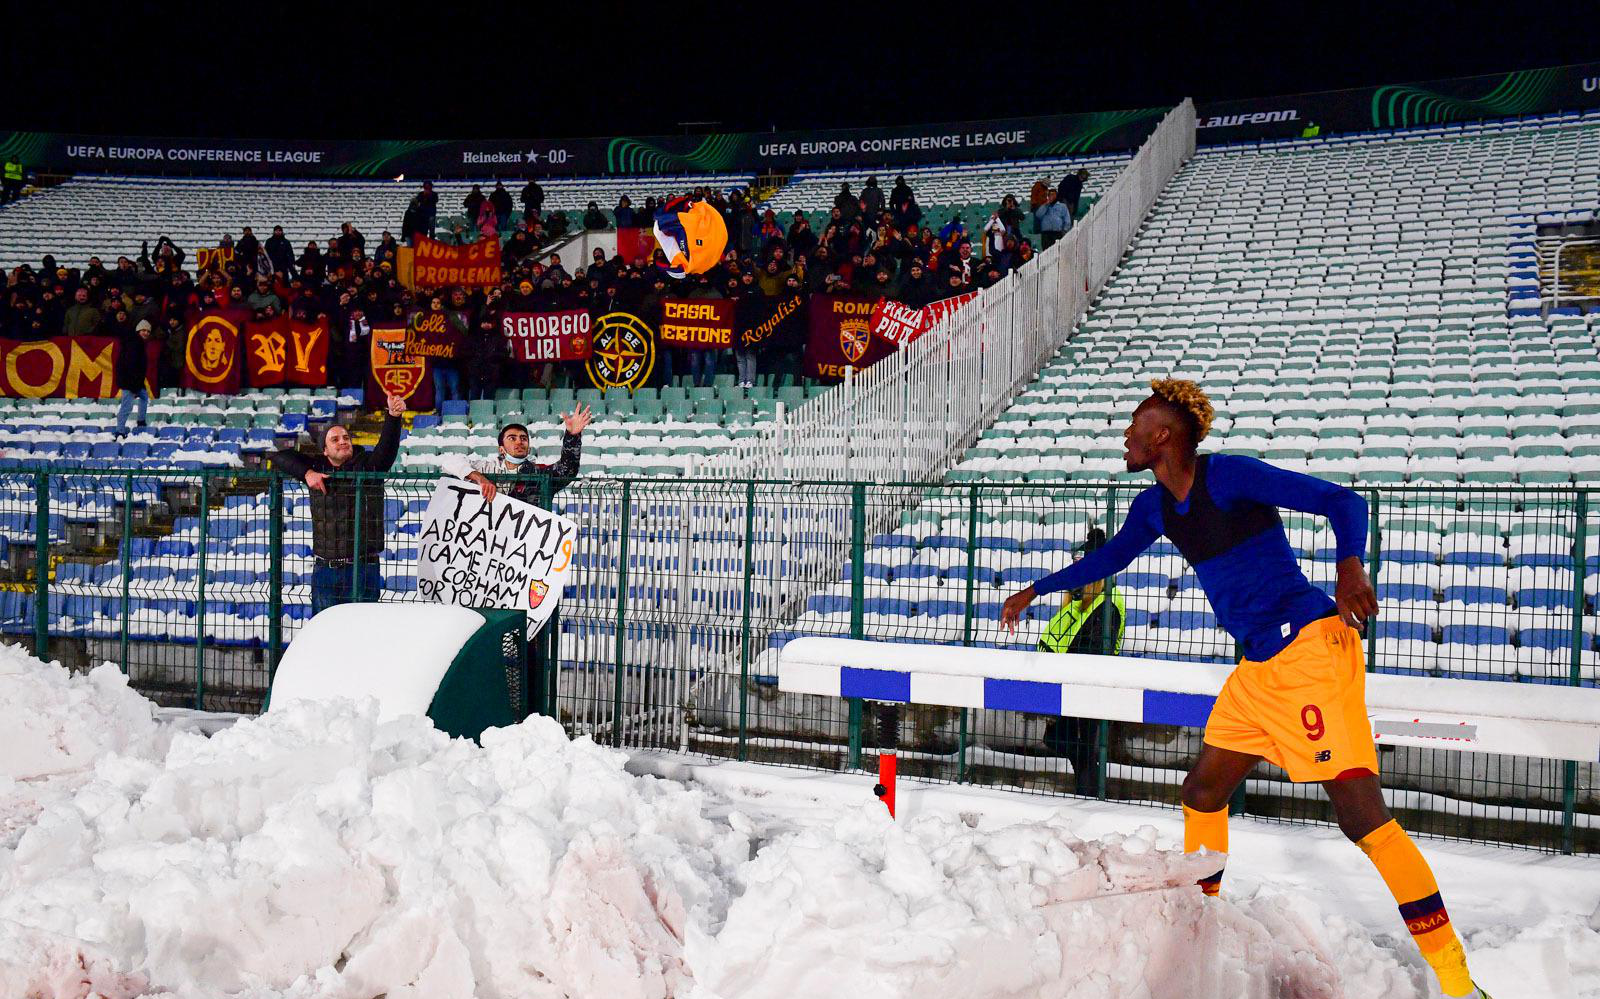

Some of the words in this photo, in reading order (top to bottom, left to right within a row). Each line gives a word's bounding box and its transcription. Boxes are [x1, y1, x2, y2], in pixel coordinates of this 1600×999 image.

[67, 146, 104, 158] UEFA
[109, 147, 164, 160] EUROPA
[167, 149, 262, 162] CONFERENCE
[267, 151, 321, 163] LEAGUE
[759, 144, 797, 157] UEFA
[800, 141, 857, 155] EUROPA
[860, 135, 961, 152] CONFERENCE
[966, 131, 1026, 147] LEAGUE
[463, 151, 521, 164] Heineken
[416, 265, 500, 283] PROBLEMA
[414, 312, 446, 333] Colli
[665, 302, 720, 321] CASAL
[741, 295, 802, 347] Royalist
[882, 301, 923, 329] PIAZZA
[503, 313, 590, 337] S.GIORGIO
[875, 316, 901, 340] PIO
[525, 338, 560, 359] LIRI
[0, 339, 155, 400] OM
[448, 486, 571, 554] TAMMY
[421, 519, 554, 576] ABRAHAM
[552, 540, 571, 573] 9
[420, 543, 426, 561] I
[428, 543, 483, 575] CAME
[485, 558, 528, 590] FROM
[419, 578, 445, 602] FOR
[442, 567, 519, 607] COBHAM
[1301, 704, 1325, 741] 9
[1408, 914, 1446, 931] OMA
